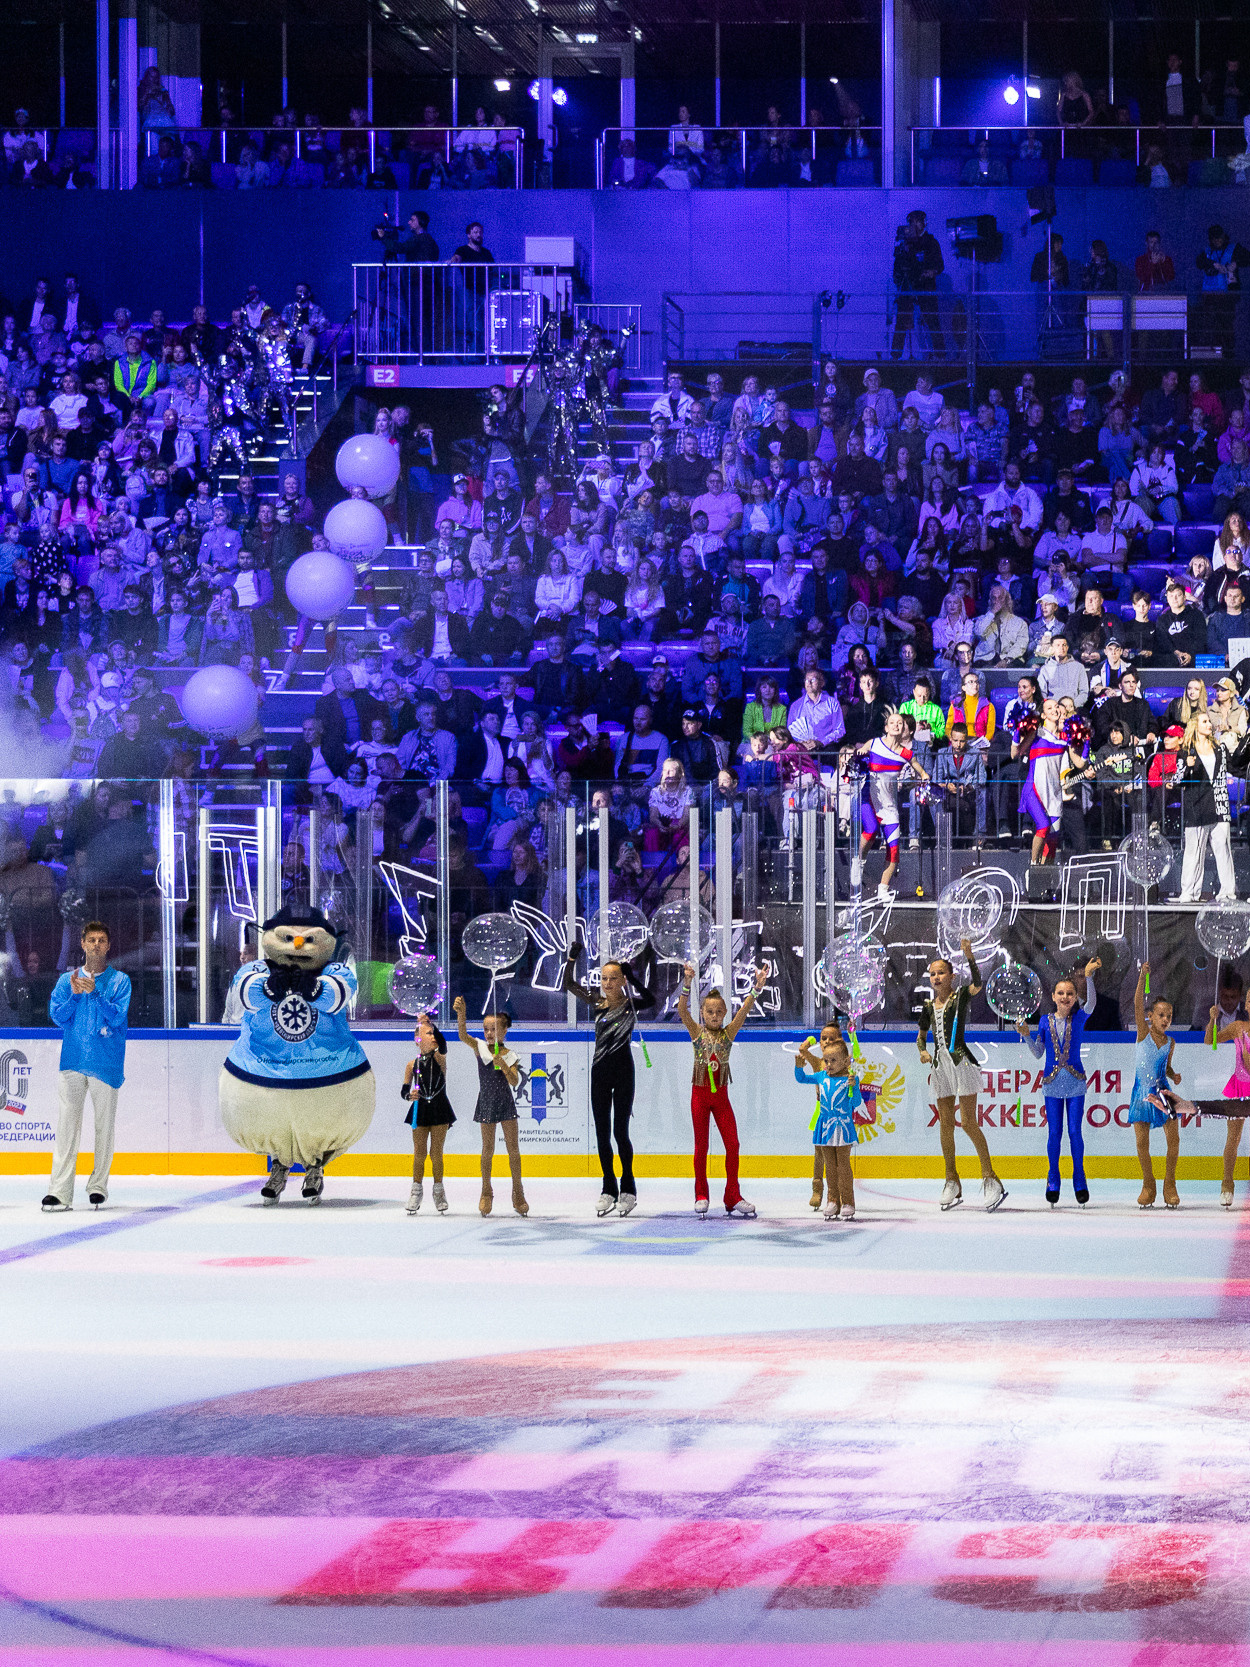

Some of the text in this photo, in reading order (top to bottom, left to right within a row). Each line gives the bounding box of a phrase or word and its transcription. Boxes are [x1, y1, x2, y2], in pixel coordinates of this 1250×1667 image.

[373, 369, 395, 383] E2
[13, 1067, 32, 1075] ЛЕТ
[860, 1084, 882, 1095] РОССИИ
[927, 1104, 1049, 1127] ХККЕЯ
[15, 1122, 51, 1130] СПОРТА
